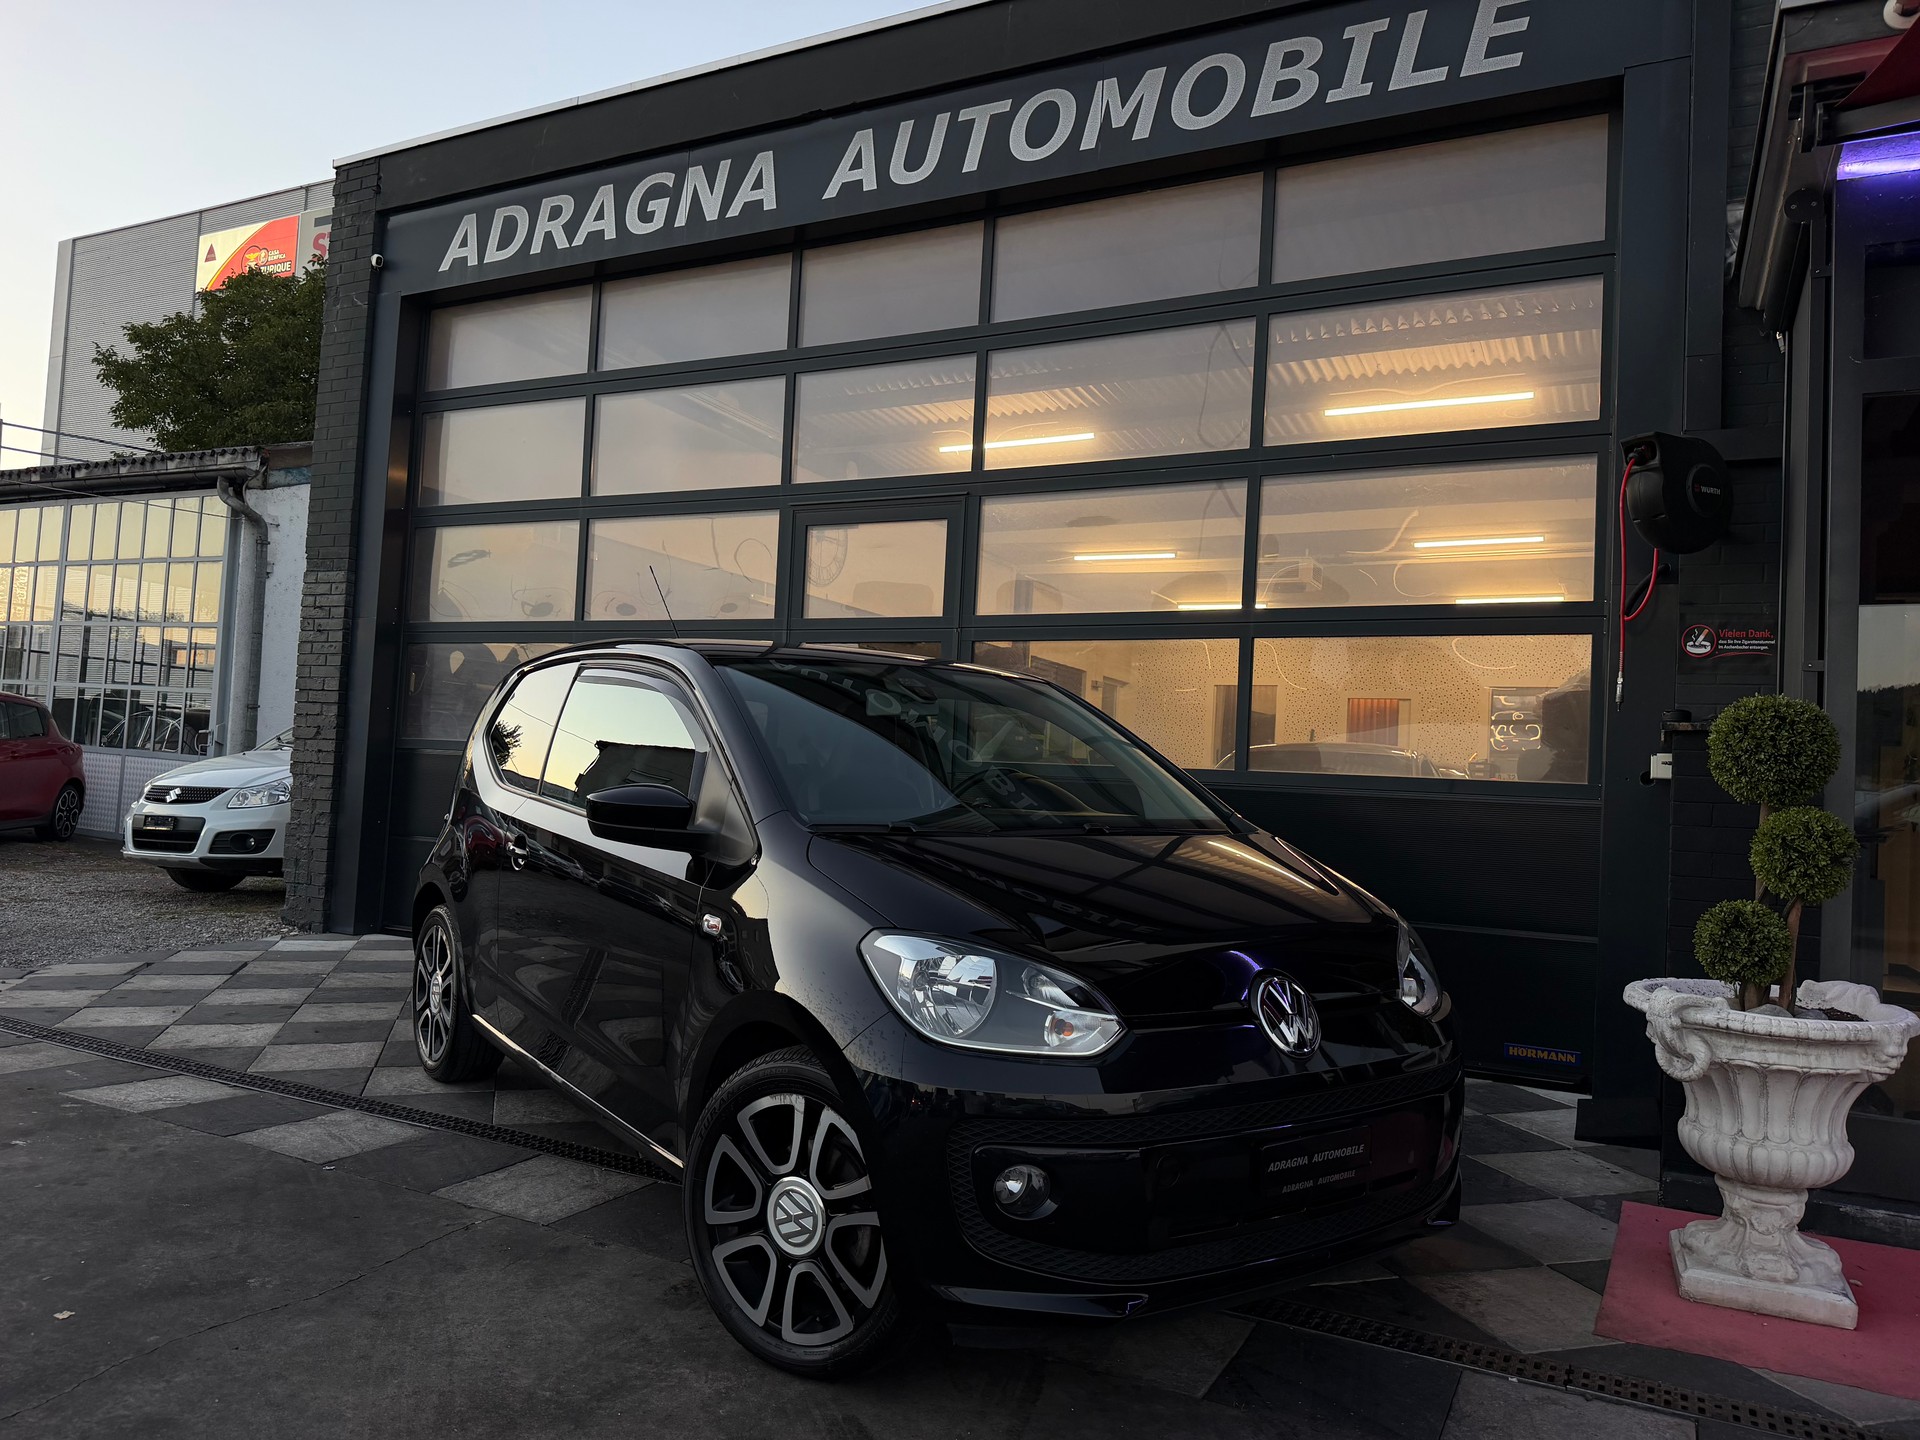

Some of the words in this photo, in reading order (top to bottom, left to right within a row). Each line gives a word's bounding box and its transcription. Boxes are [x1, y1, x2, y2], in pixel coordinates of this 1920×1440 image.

[438, 150, 777, 273] ADRAGNA
[821, 0, 1531, 200] AUTOMOBILE
[1718, 629, 1746, 638] Vielen
[1267, 1155, 1309, 1173] ADRAGNA
[1312, 1144, 1365, 1163] AUTOMOBILE
[1281, 1179, 1314, 1194] ADRAGNA
[1317, 1169, 1356, 1185] AUTOMOBILE
